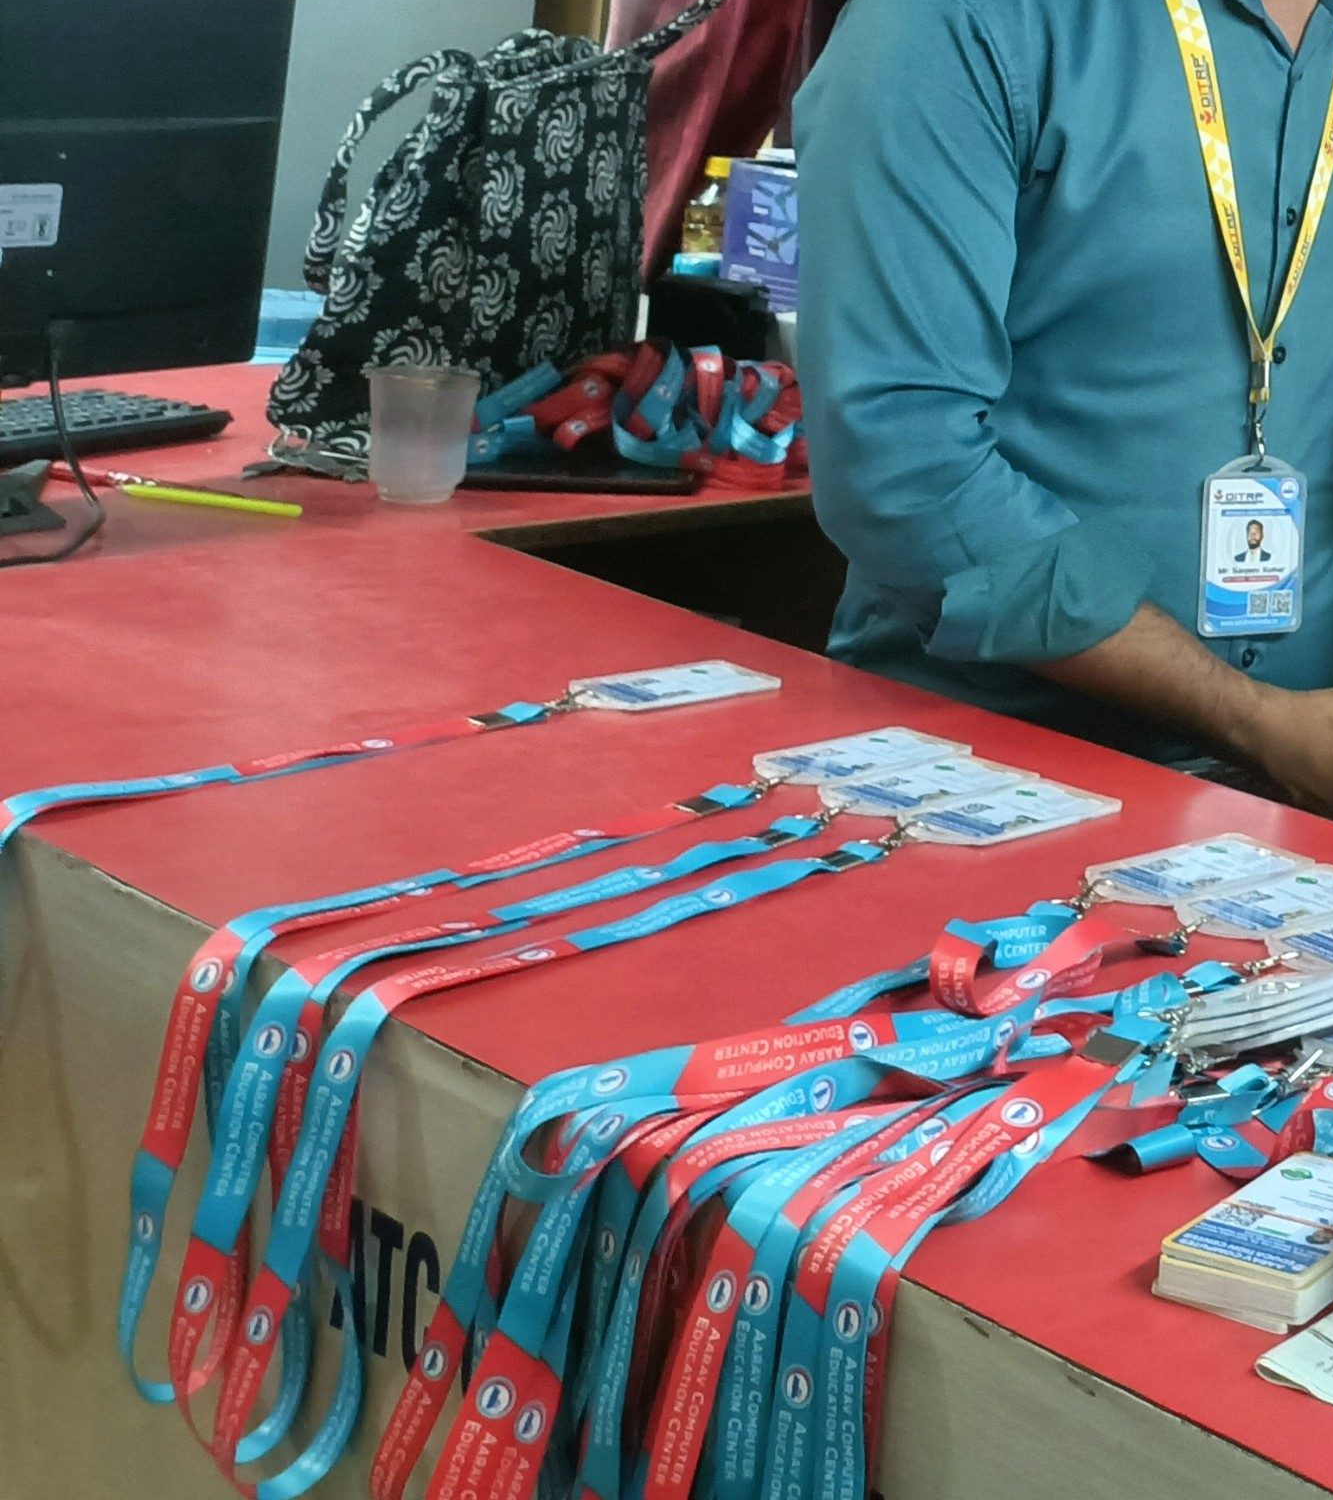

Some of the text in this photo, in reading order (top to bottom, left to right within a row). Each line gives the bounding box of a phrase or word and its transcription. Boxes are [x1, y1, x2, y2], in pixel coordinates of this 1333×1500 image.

[155, 996, 195, 1131] EDUCATION CENTER
[172, 1004, 206, 1128] AARAV COMPUTER
[713, 1024, 844, 1060] EDUCATION CENTER
[716, 1045, 843, 1078] AARAV COMPUTER
[215, 1062, 258, 1197] EDUCATION CENTER
[232, 1070, 272, 1196] AARAV COMPUTER
[282, 1086, 330, 1226] EDUCATION CENTER
[298, 1094, 342, 1226] AARAV COMPUTER
[808, 1162, 926, 1274] EDUCATION CENTER
[655, 1316, 709, 1485] EDUCATION CENTER
[672, 1328, 720, 1484] AARAV COMPUTER
[724, 1320, 750, 1482] EDUCATION CENTER
[743, 1328, 766, 1478] AARAV COMPUTER
[826, 1347, 842, 1440] EDUCATION
[842, 1357, 858, 1414] AARAV
